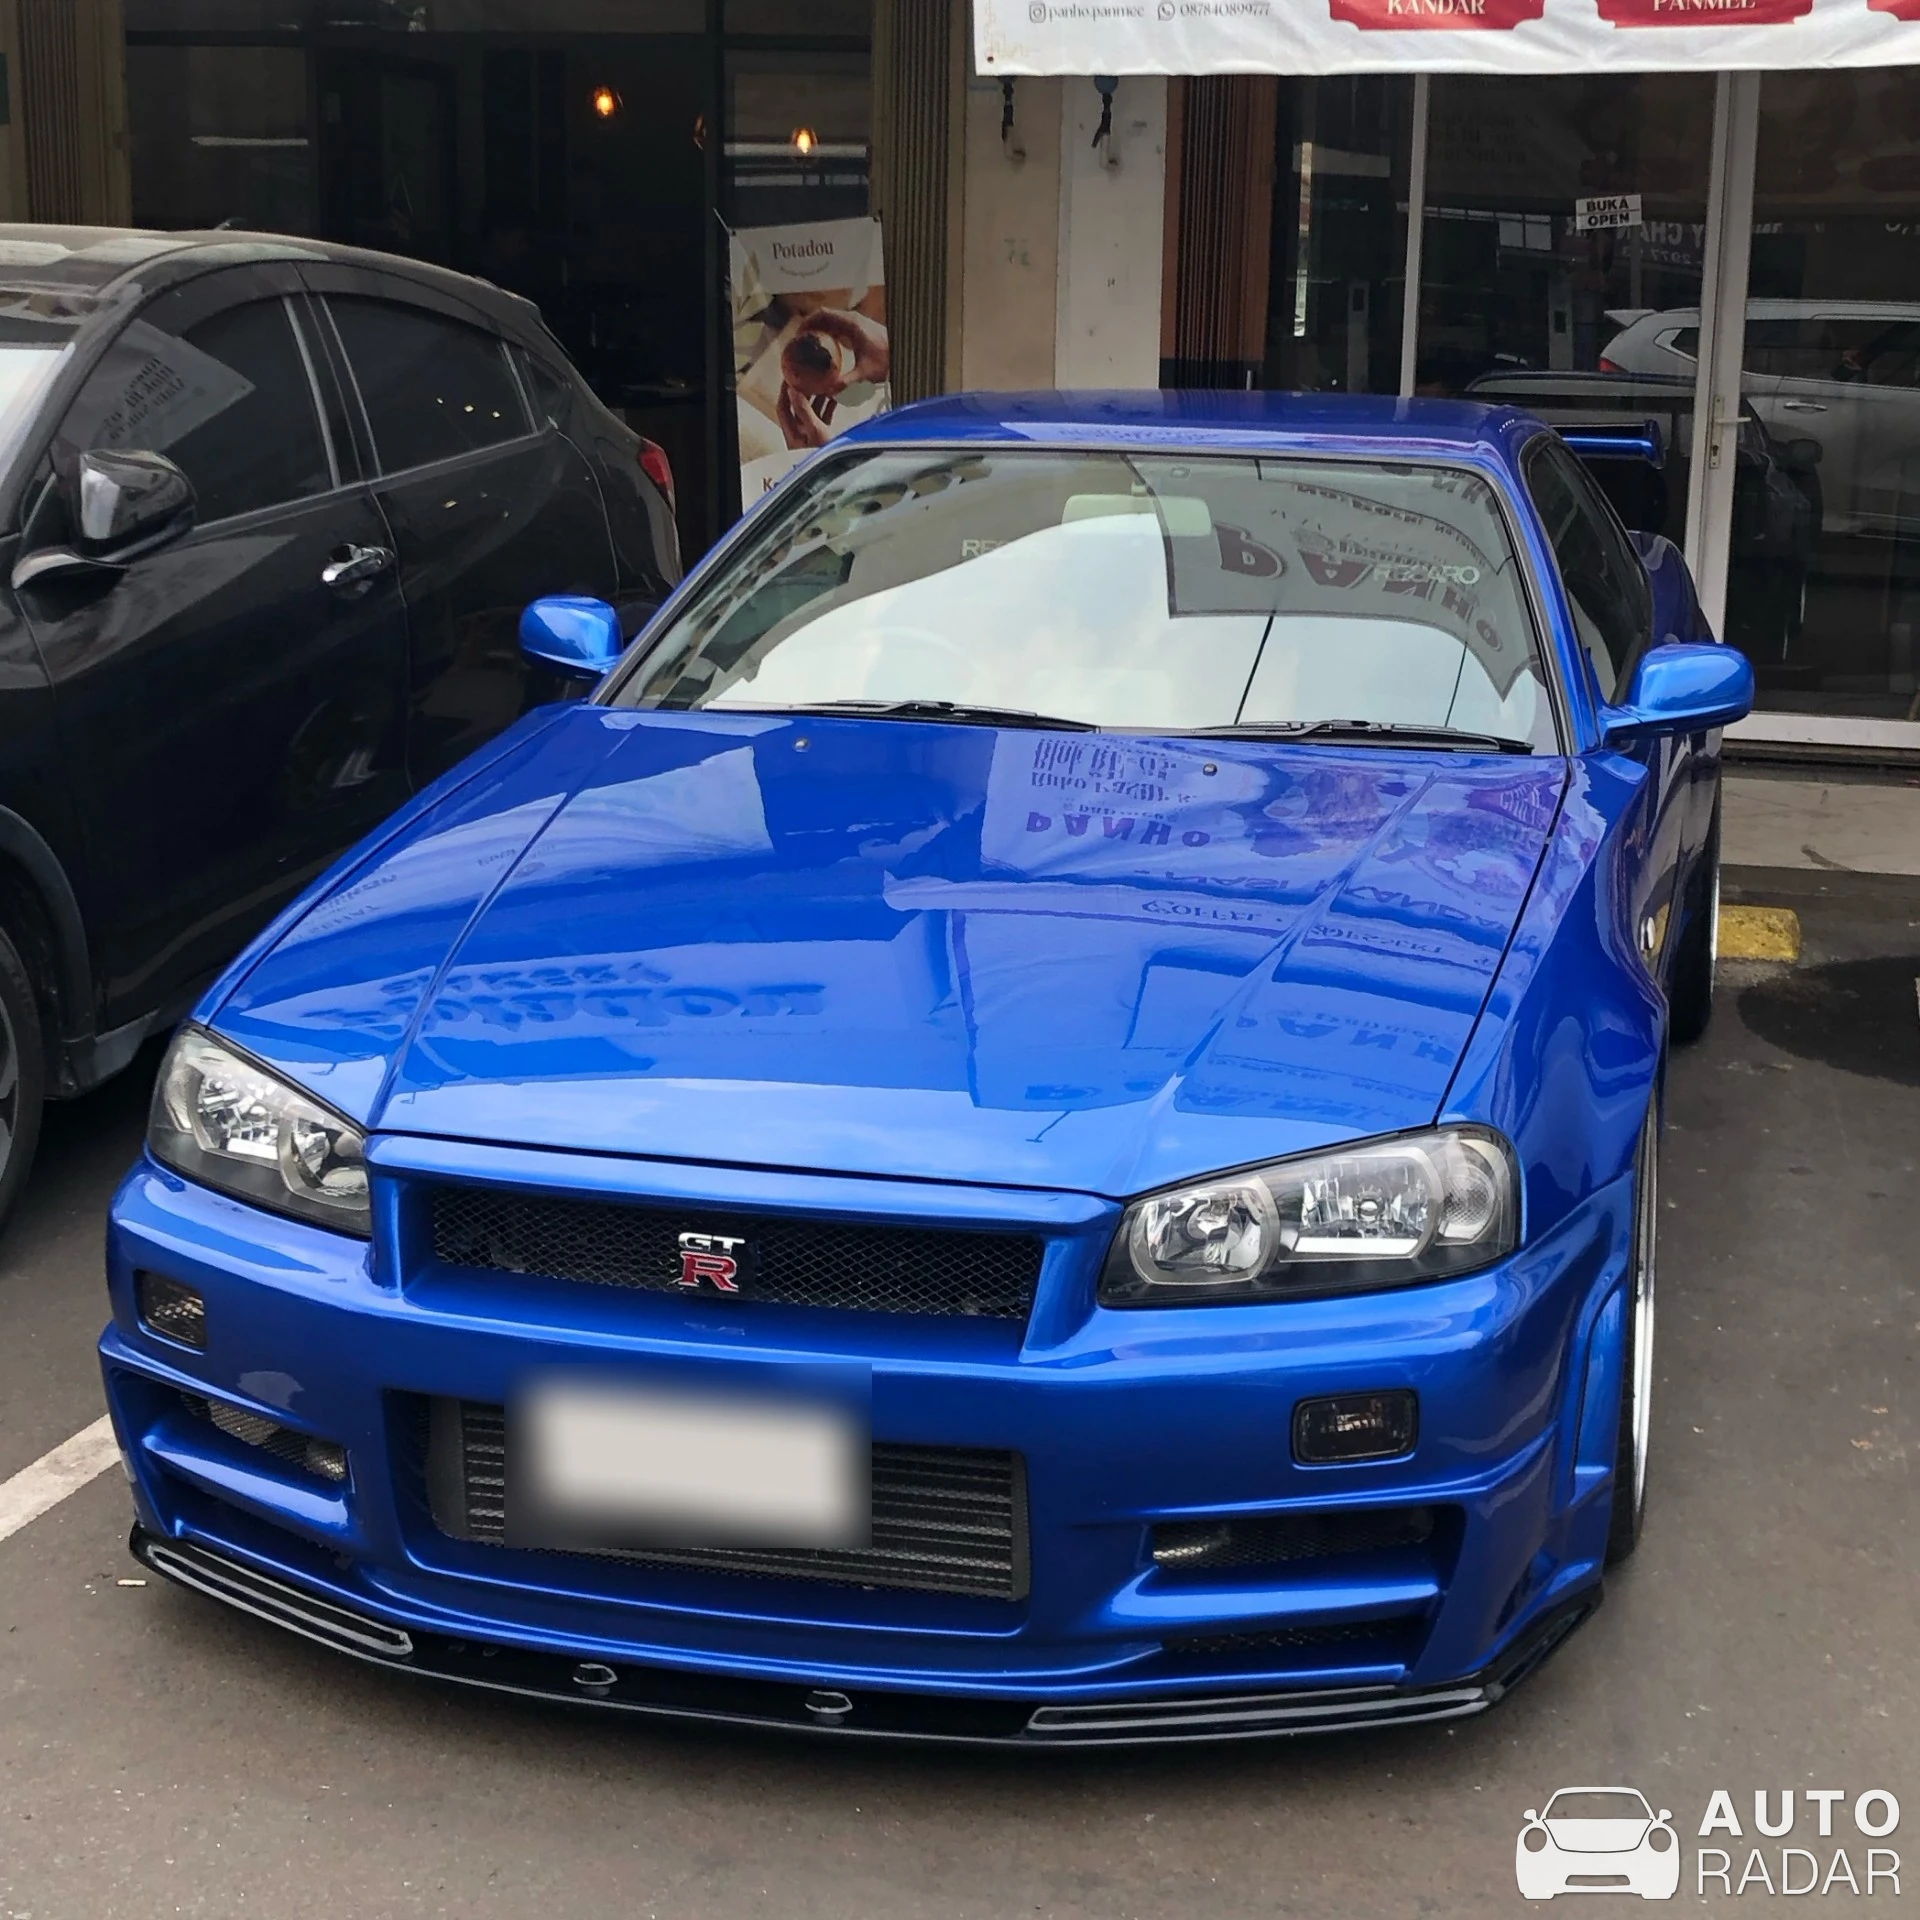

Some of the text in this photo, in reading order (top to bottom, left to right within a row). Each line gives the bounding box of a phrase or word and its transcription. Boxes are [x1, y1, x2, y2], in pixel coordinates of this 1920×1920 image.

[1586, 199, 1629, 212] BUKA
[1588, 213, 1630, 226] OPEN
[772, 239, 834, 260] Potadou
